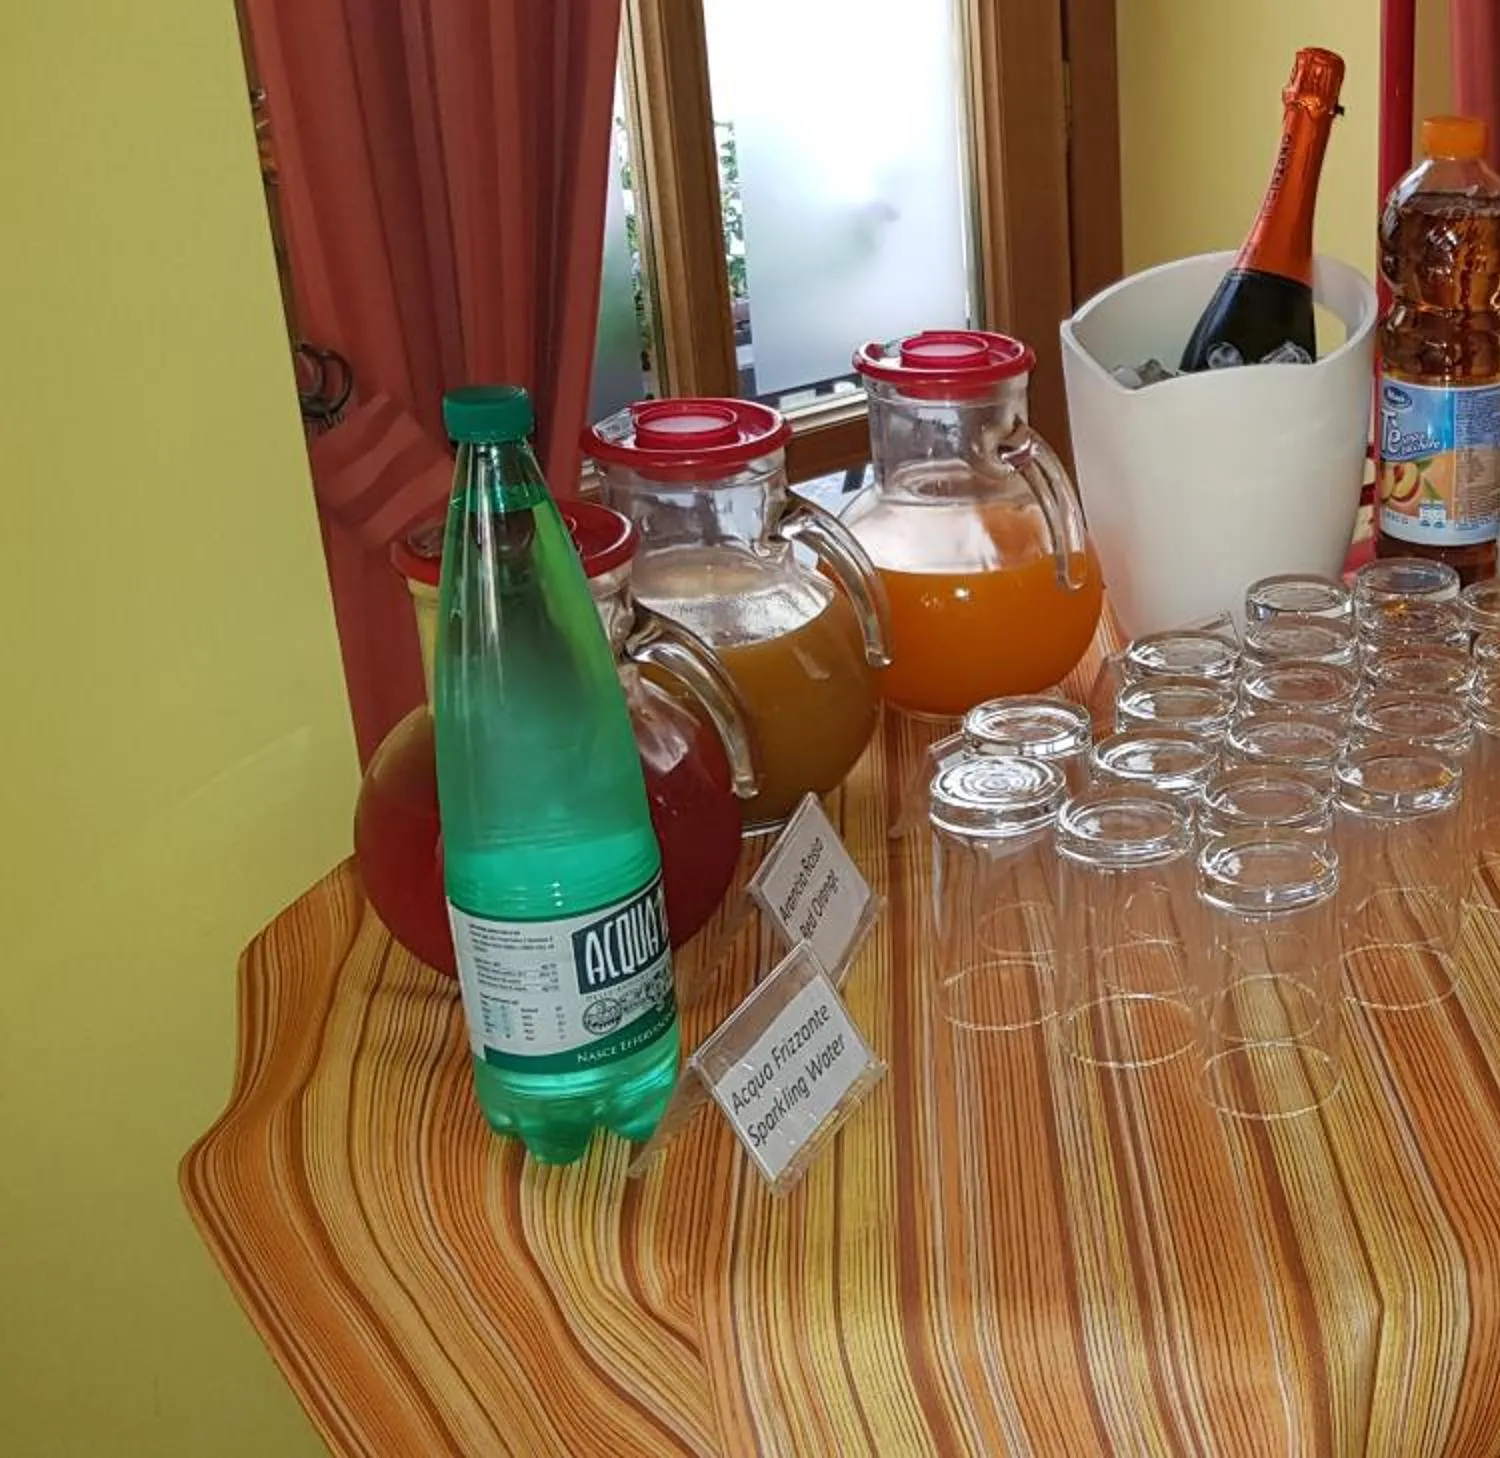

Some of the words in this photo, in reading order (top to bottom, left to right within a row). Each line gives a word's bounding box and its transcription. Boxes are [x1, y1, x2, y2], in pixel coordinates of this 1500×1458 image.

[585, 895, 660, 985] ACQUA
[731, 1062, 774, 1114] Acqua
[771, 1004, 831, 1070] Frizzante
[748, 1075, 811, 1148] Sparkling
[805, 1033, 846, 1083] Water
